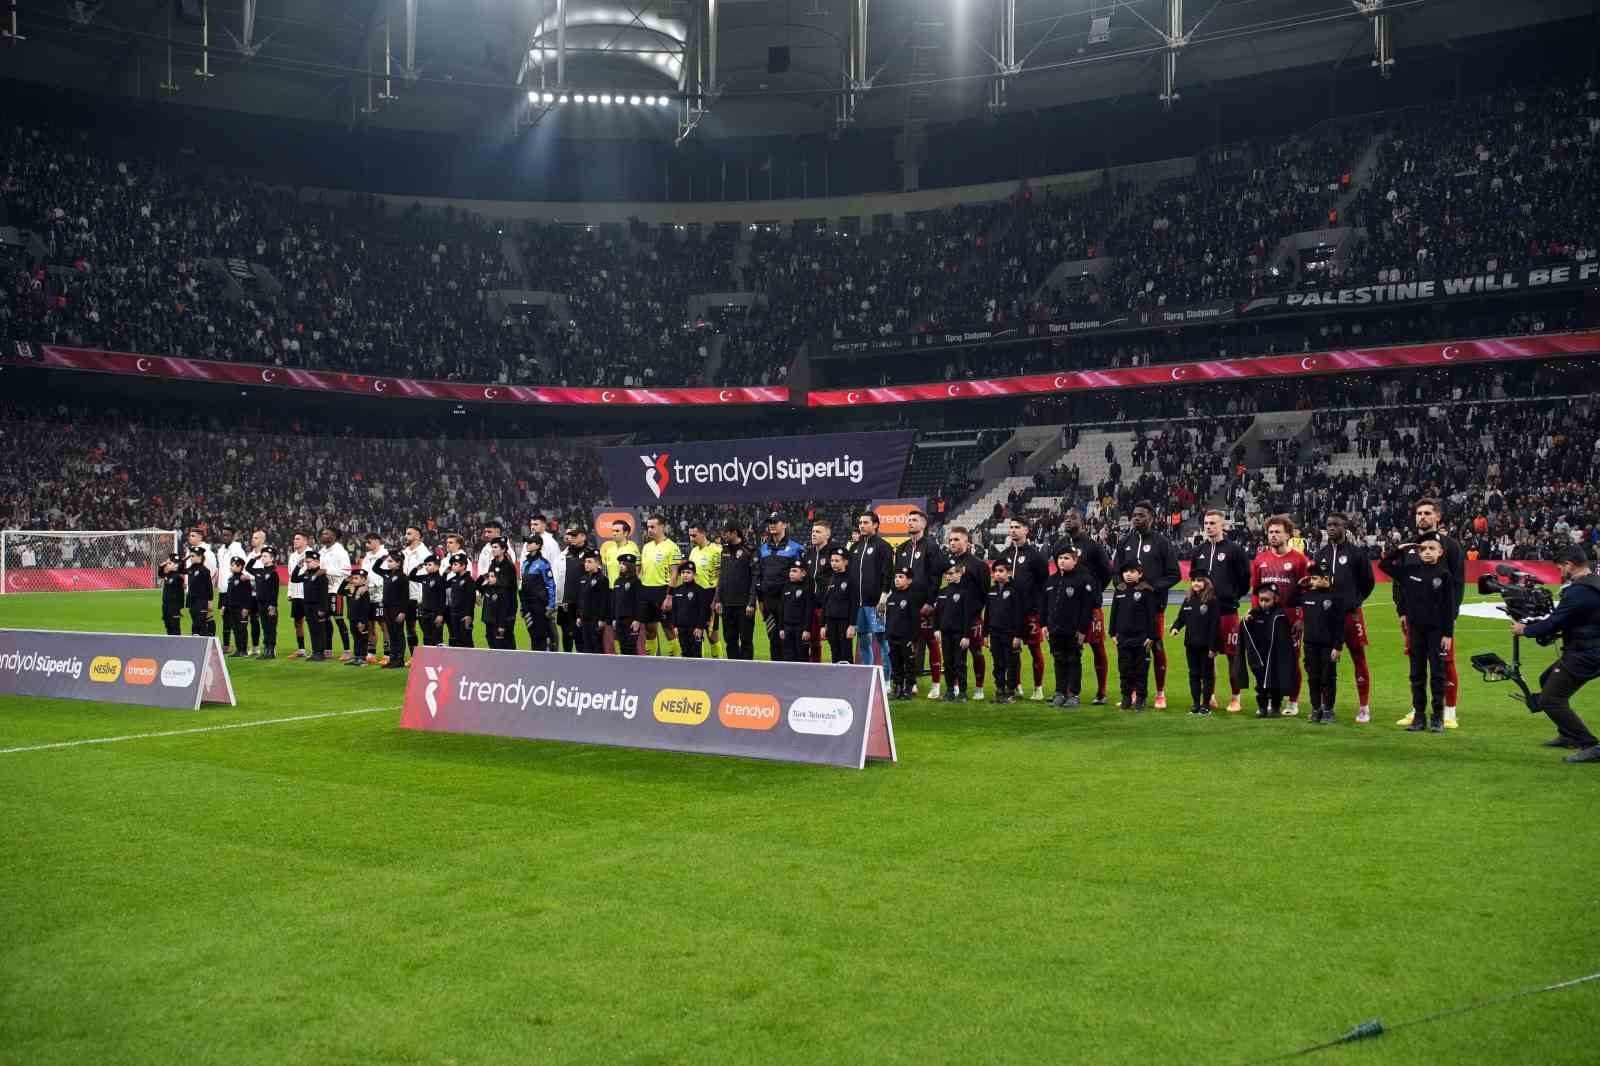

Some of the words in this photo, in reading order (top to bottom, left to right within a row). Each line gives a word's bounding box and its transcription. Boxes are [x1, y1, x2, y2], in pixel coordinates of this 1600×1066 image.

[1287, 281, 1434, 305] PALESTINE
[1443, 273, 1518, 295] WILL
[1528, 266, 1569, 285] BE
[1579, 263, 1600, 280] F
[674, 455, 773, 486] trendyol
[1227, 632, 1239, 645] 10
[1354, 623, 1363, 636] 3
[459, 675, 554, 711] trendyol
[725, 704, 775, 719] trendyol
